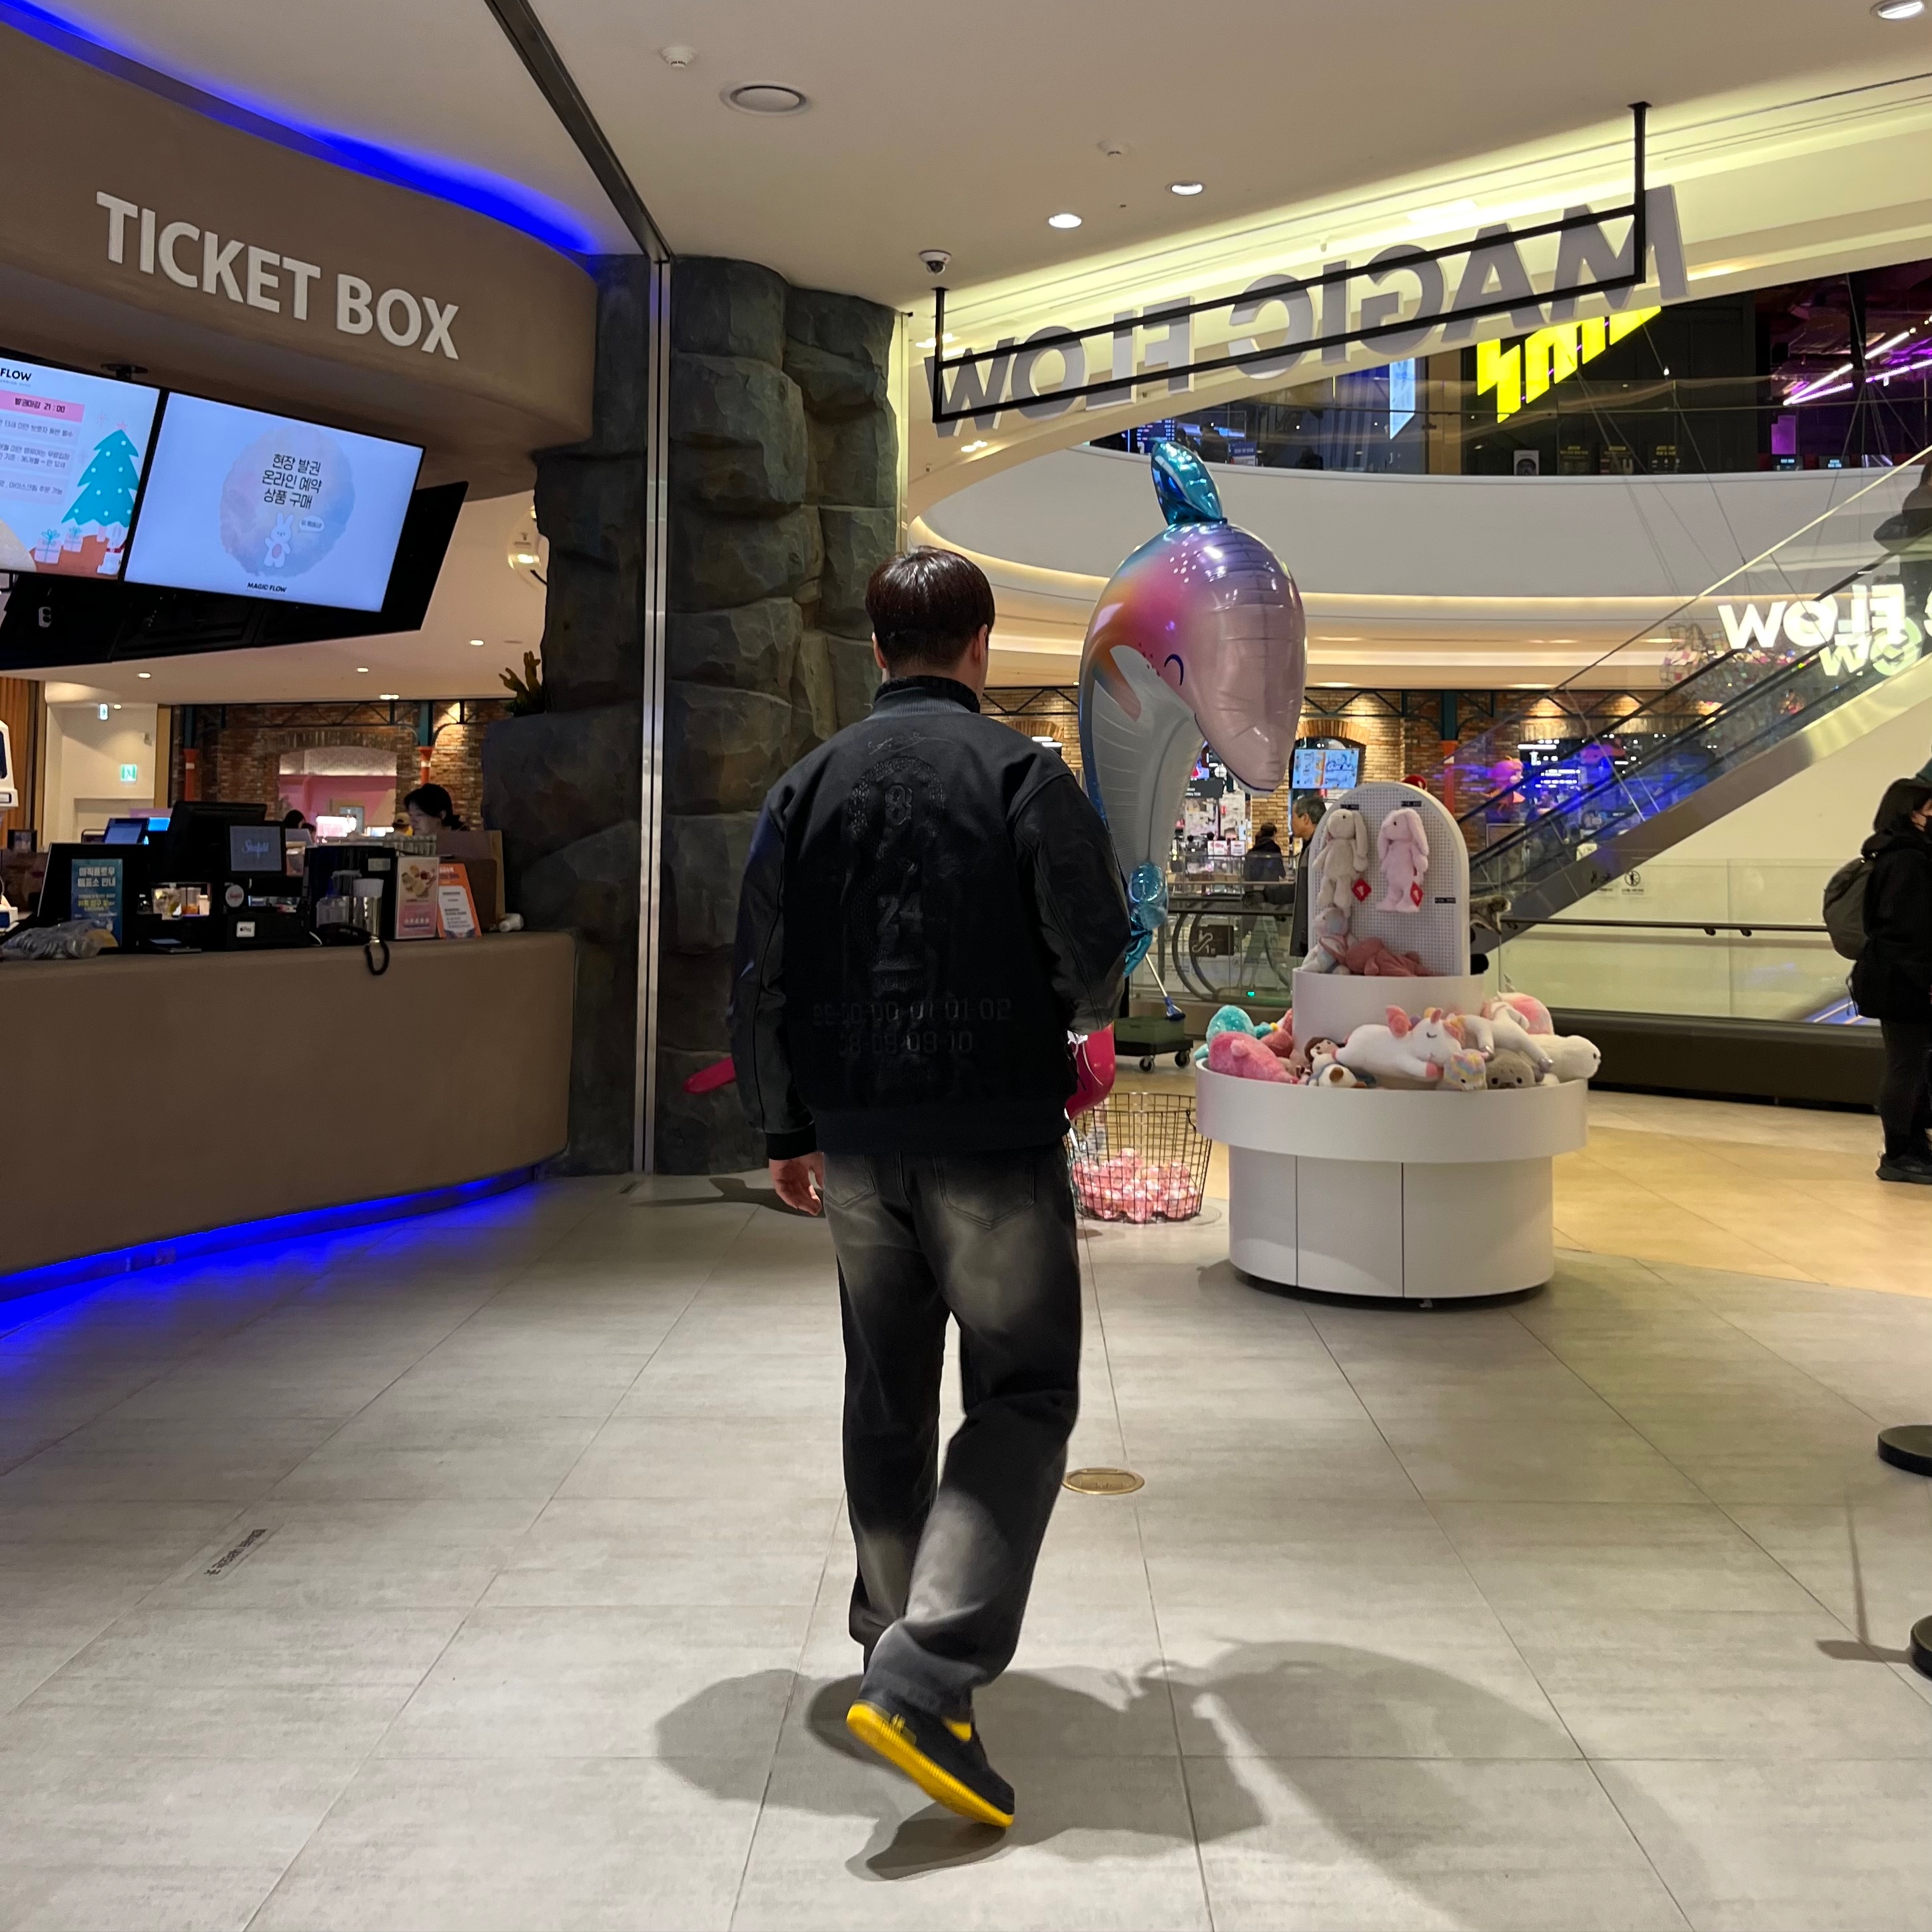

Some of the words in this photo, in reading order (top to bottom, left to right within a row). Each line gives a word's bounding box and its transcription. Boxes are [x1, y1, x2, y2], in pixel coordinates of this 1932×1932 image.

[96, 191, 321, 321] TICKET
[336, 273, 460, 360] BOX
[0, 368, 32, 382] FLOW
[272, 454, 295, 471] 현장
[297, 458, 321, 476] 발권
[262, 470, 298, 490] 온라인
[298, 476, 322, 494] 예약
[264, 488, 287, 505] 상품
[289, 492, 312, 510] 구매
[247, 582, 268, 591] MAGIC
